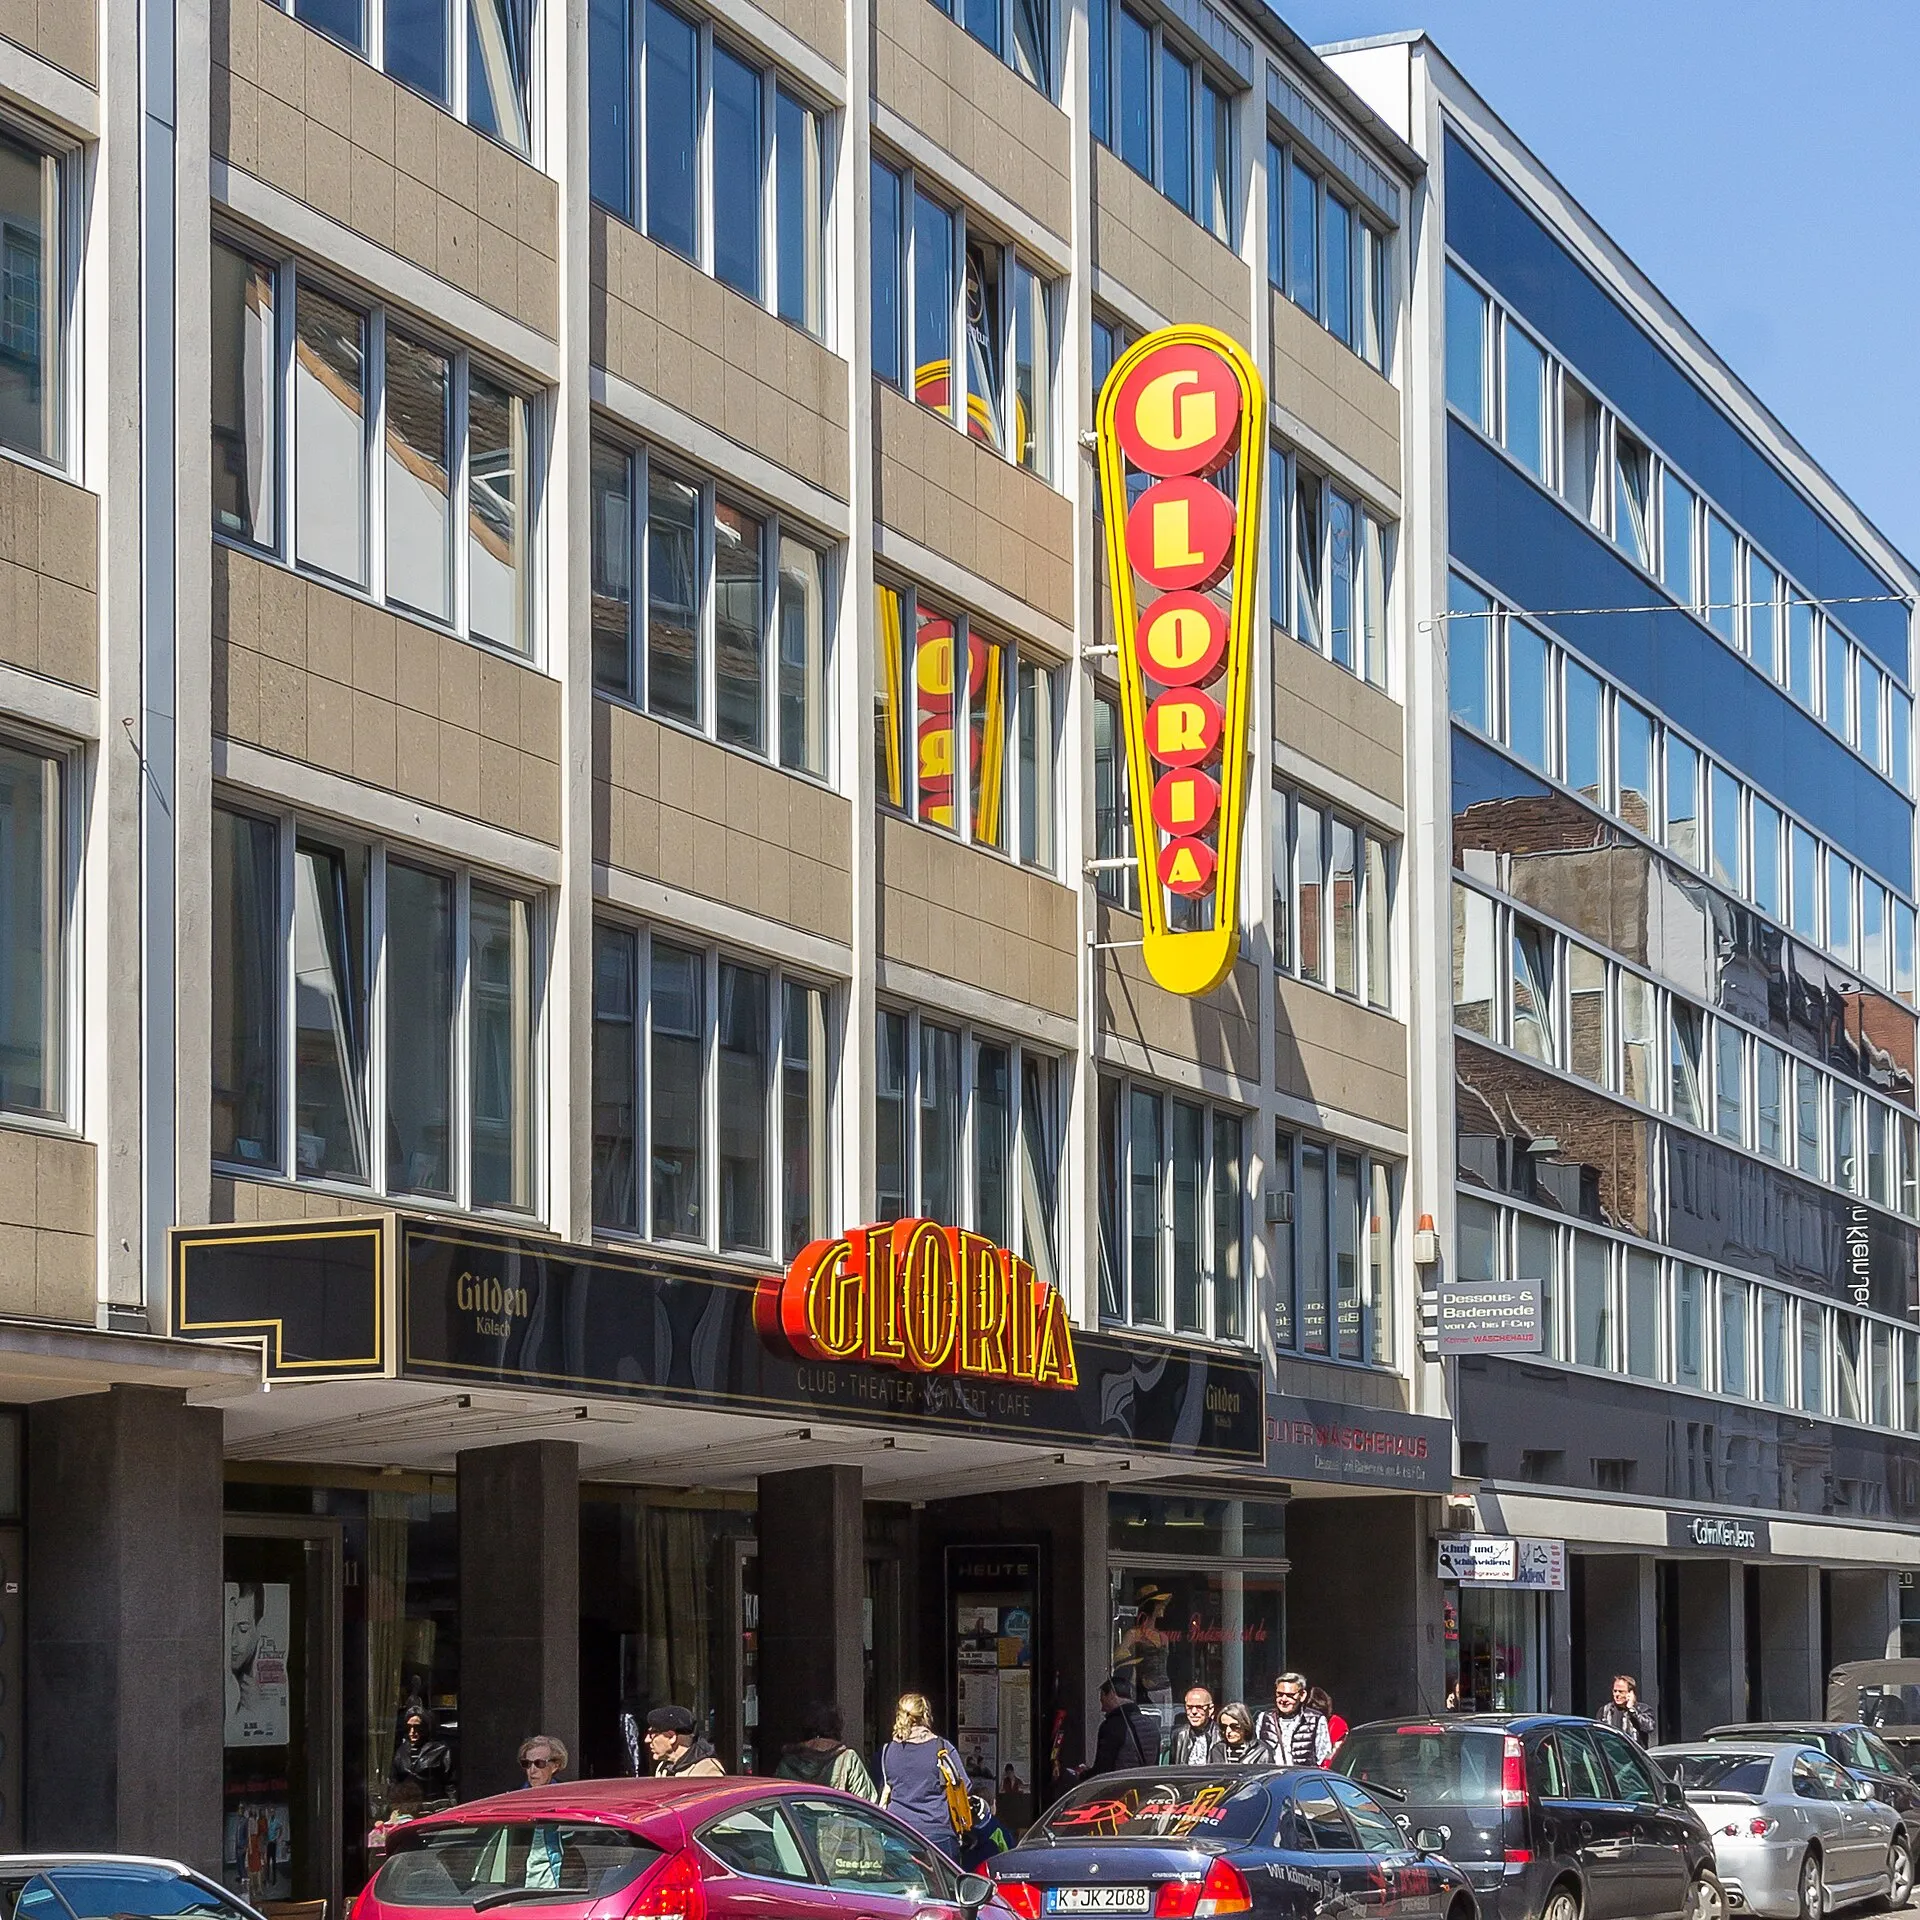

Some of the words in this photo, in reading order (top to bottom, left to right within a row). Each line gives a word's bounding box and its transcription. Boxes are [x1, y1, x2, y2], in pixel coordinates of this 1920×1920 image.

[1134, 370, 1217, 885] GLORIA
[457, 1271, 528, 1318] Gilden
[803, 1218, 1080, 1388] GLORIA
[1443, 1294, 1515, 1304] Dessous-
[1520, 1291, 1534, 1301] &
[1443, 1305, 1535, 1318] Bademode
[476, 1316, 511, 1337] Kölsch
[797, 1367, 836, 1394] CLUB
[850, 1374, 914, 1404] THEATER
[998, 1392, 1031, 1416] CAFE
[1206, 1384, 1240, 1413] Gilden
[1266, 1416, 1314, 1446] ÖLNER
[1315, 1421, 1428, 1459] WÄSCHEHAUS
[1441, 1544, 1470, 1553] Schuh
[1474, 1545, 1493, 1553] und
[958, 1563, 1029, 1576] HEUTE
[1135, 1813, 1220, 1827] SPRMBERG
[1265, 1862, 1286, 1881] Wir
[1058, 1889, 1069, 1907] K
[1080, 1889, 1101, 1907] JK
[1105, 1888, 1145, 1907] 2088
